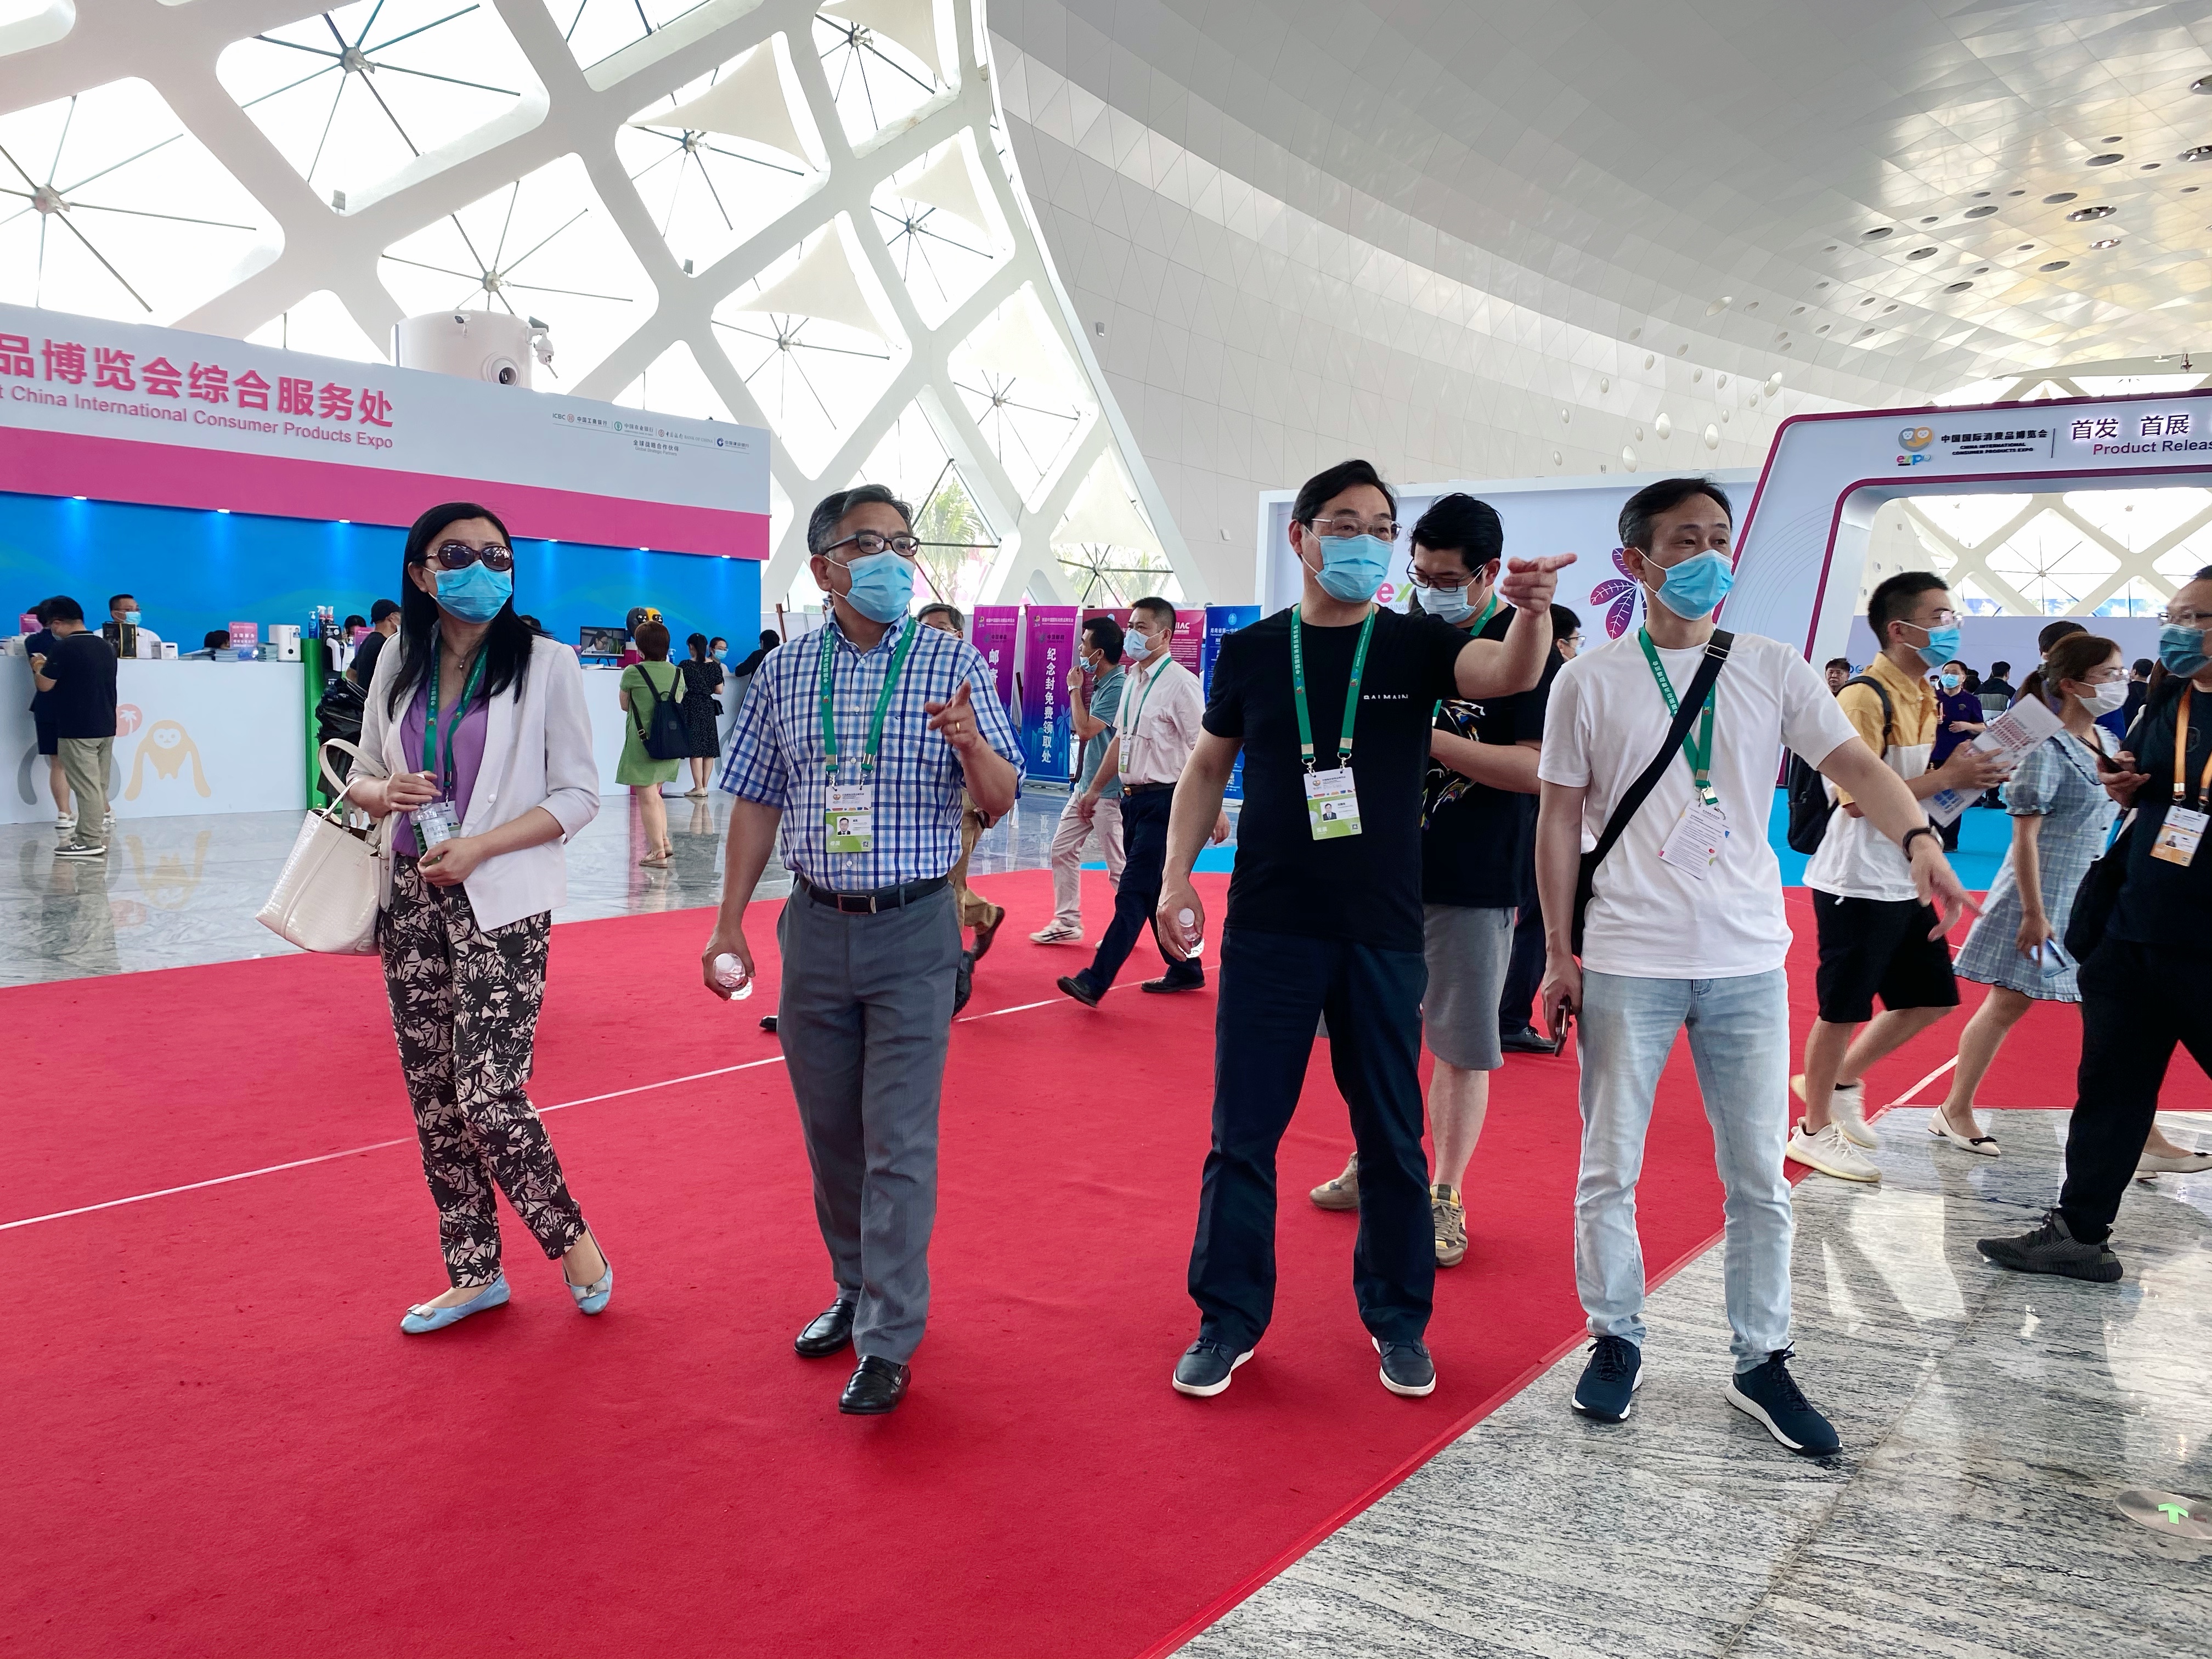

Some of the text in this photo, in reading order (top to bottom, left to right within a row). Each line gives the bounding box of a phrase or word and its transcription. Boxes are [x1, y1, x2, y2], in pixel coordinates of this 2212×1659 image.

[0, 333, 394, 427] 品博览会综合服务处
[10, 385, 67, 407] China
[75, 393, 187, 422] International
[194, 410, 278, 433] Consumer
[284, 421, 352, 443] Products
[357, 431, 393, 450] Expo
[577, 416, 607, 426] 中国工商银行
[624, 422, 653, 433] 中国农业银行
[2072, 414, 2190, 441] 首发 首展
[1941, 429, 2048, 443] 中国国际消费品博览会
[633, 439, 679, 452] 全球战略合作伙伴
[2093, 442, 2157, 455] Product
[1042, 647, 1057, 763] 纪念封免费领取处
